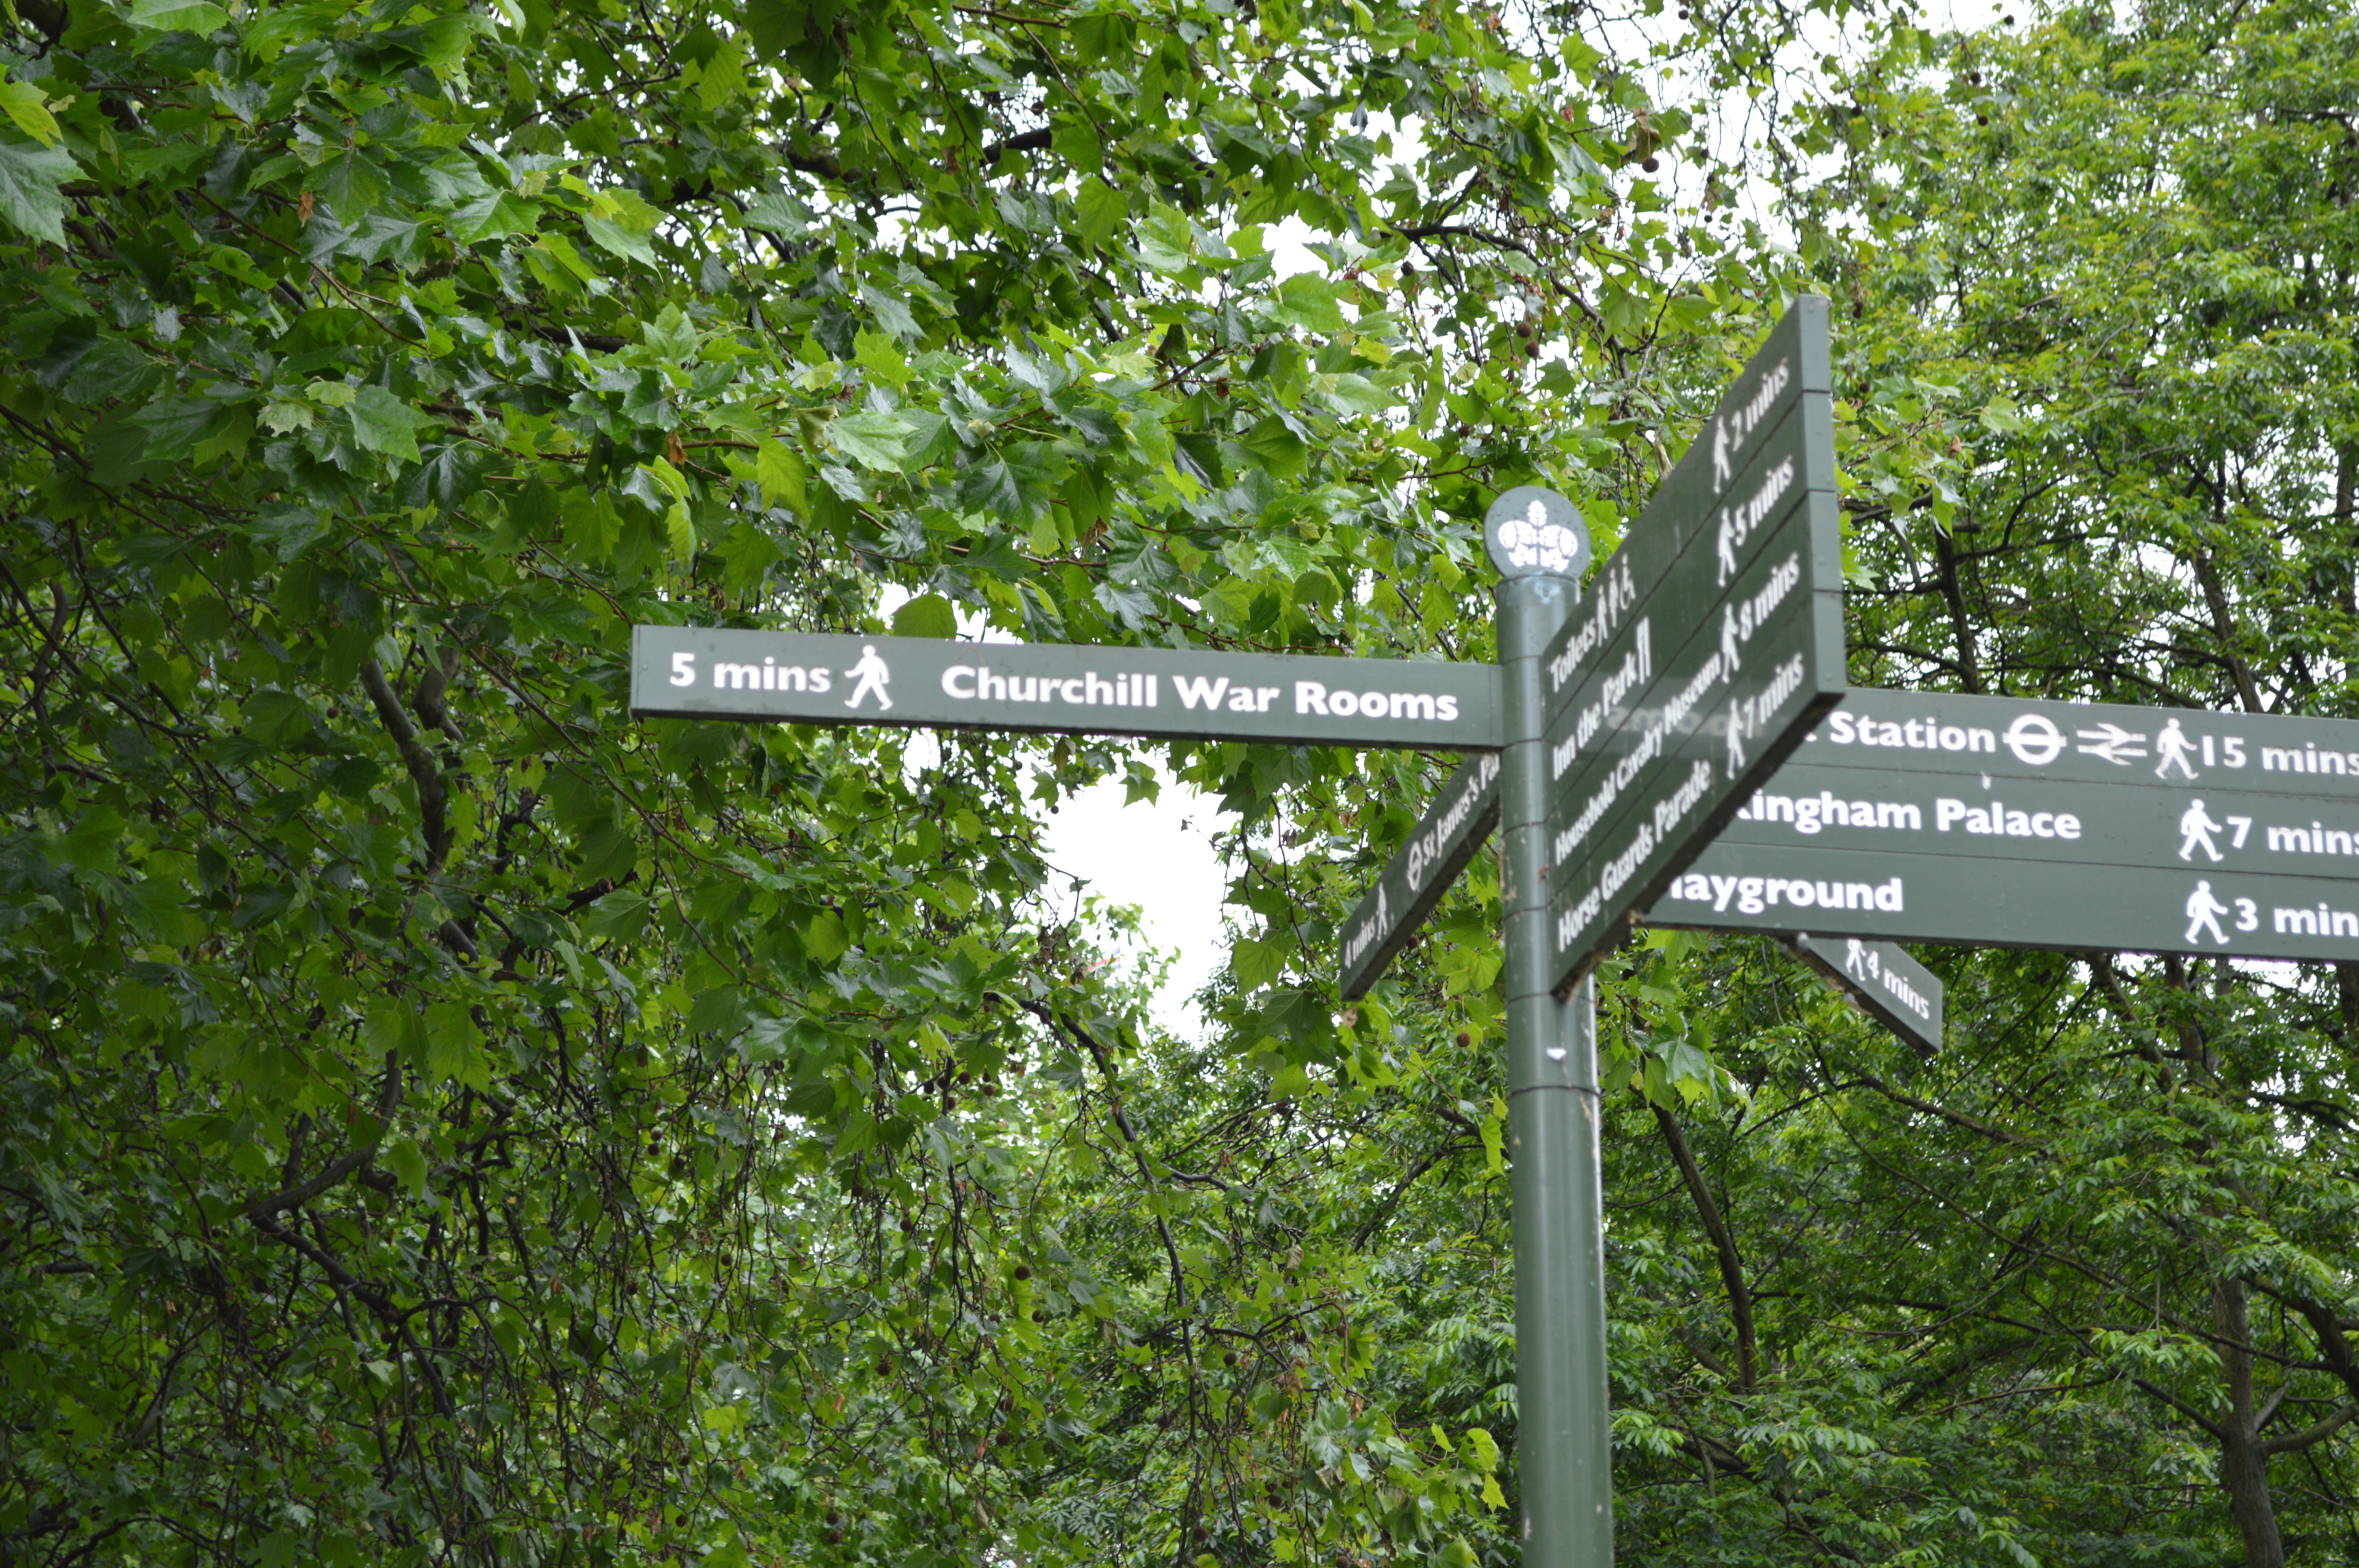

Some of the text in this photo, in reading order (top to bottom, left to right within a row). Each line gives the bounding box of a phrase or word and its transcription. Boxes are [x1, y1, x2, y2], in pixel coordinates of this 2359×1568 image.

[1550, 358, 1789, 693] Toilets 2 mins
[1553, 456, 1794, 780] Inn the Park 5 mins
[669, 652, 831, 694] 5 mins
[941, 665, 1459, 721] Churchill War Rooms
[1556, 552, 1799, 866] Household Cavalry Museum 8 mins
[1829, 710, 1996, 753] Station
[2203, 735, 2246, 769] 15
[1559, 653, 1803, 952] Horse Guards Parade 7 mins
[1737, 789, 2359, 855] ingham Palace 7 min
[1344, 940, 1352, 969] 4
[1352, 915, 1376, 962] mins
[1423, 830, 1436, 866] St
[1438, 775, 1479, 859] James's
[2235, 897, 2259, 931] 3
[1867, 950, 1930, 1020] 4 mins
